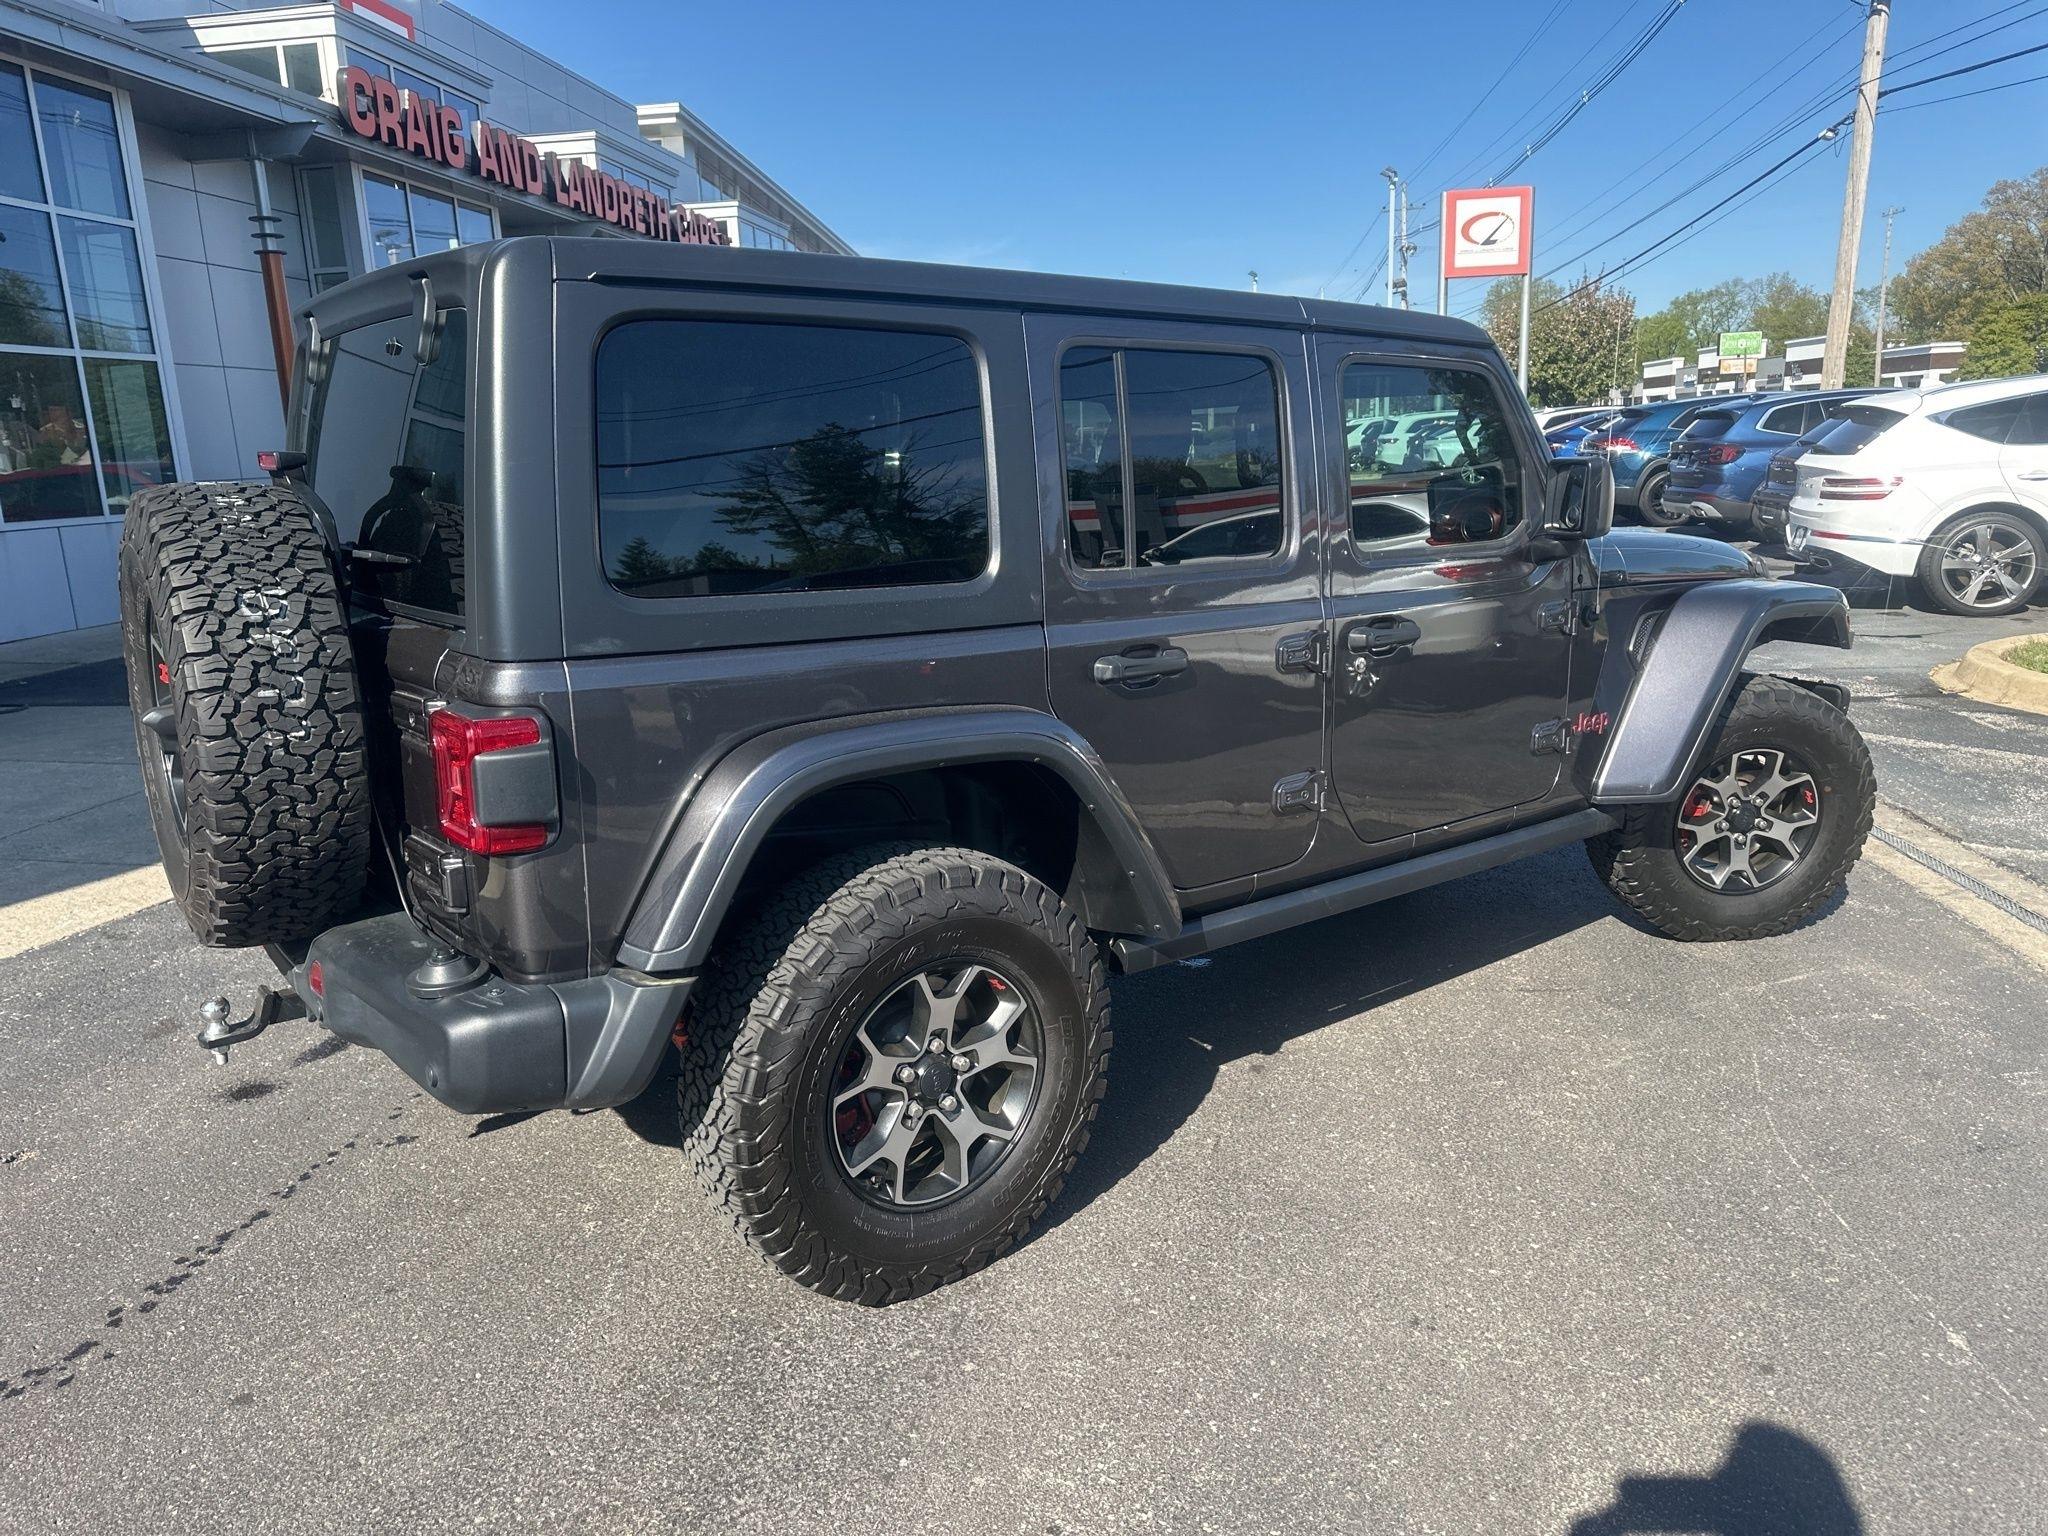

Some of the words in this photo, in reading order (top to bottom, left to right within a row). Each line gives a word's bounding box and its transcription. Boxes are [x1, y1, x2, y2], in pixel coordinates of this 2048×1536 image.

[341, 65, 467, 169] CRAIG
[477, 121, 545, 198] AND
[552, 156, 671, 241] LANDRETH
[1572, 711, 1608, 735] Jeep
